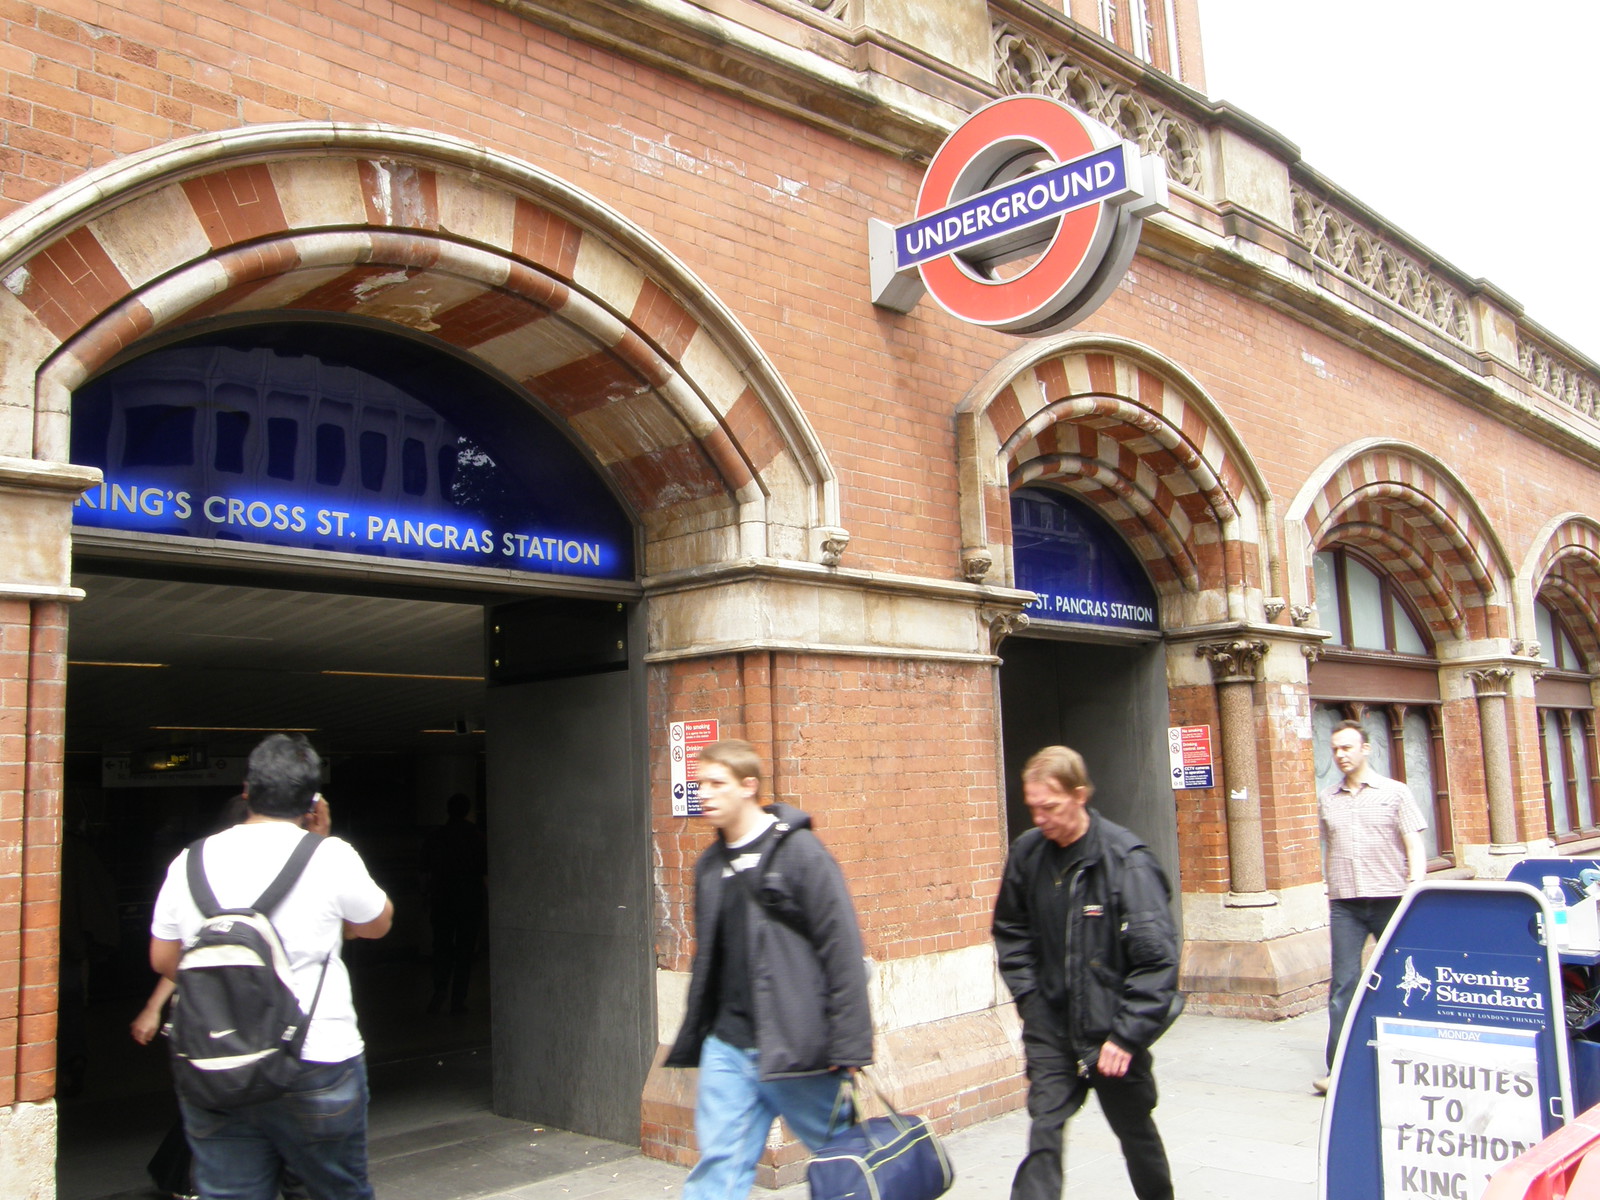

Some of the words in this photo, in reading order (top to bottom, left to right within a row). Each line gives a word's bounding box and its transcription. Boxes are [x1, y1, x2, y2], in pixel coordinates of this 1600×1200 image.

[905, 160, 1115, 255] UNDERGROUND
[203, 496, 307, 533] CROSS
[316, 509, 357, 538] ST.
[367, 515, 495, 554] PANCRAS
[502, 532, 601, 566] STATION
[1035, 592, 1053, 612] ST.
[1056, 595, 1109, 617] PANCRAS
[1111, 602, 1153, 623] STATION
[1435, 966, 1530, 993] Evening
[1436, 985, 1545, 1010] Standard
[1438, 1028, 1481, 1041] MONDAY
[1512, 1016, 1546, 1025] THINKING
[1391, 1059, 1533, 1098] TRIBUTES
[1420, 1095, 1464, 1122] TO
[1401, 1165, 1468, 1200] KING
